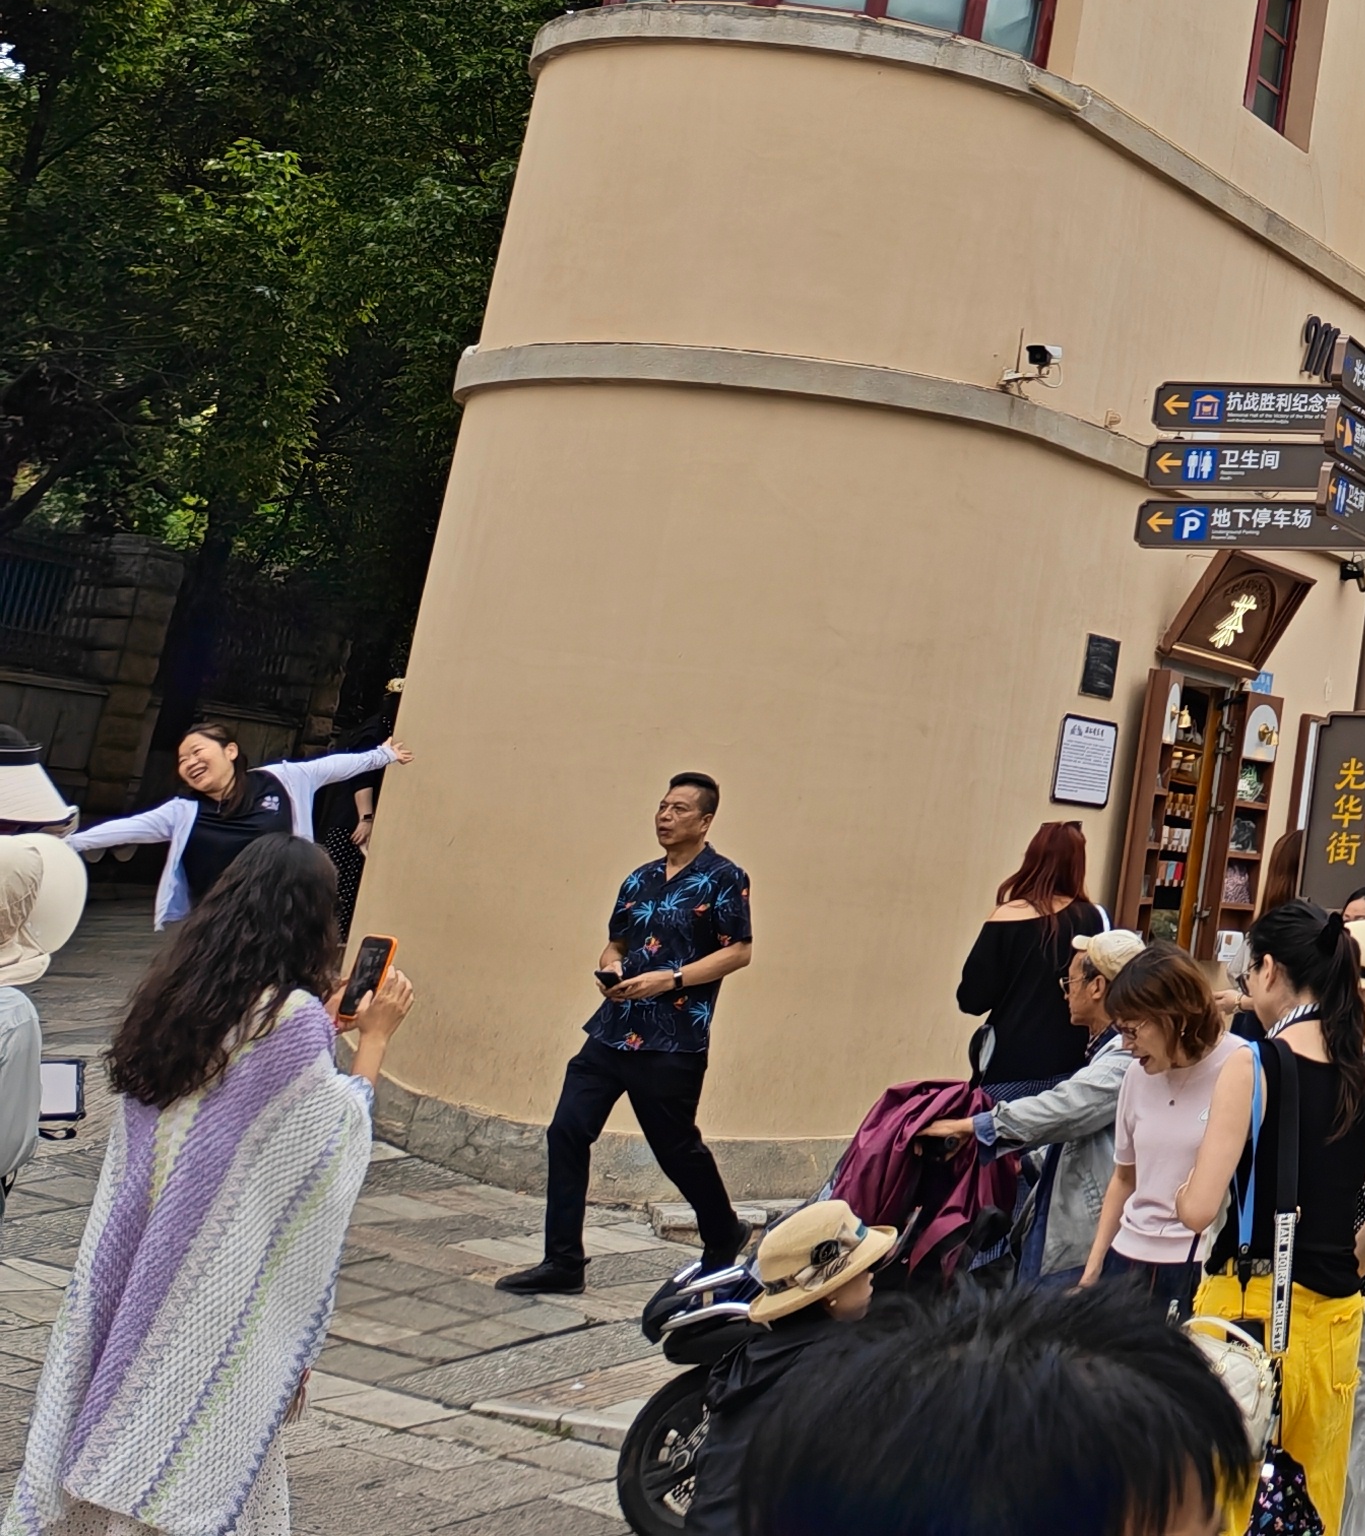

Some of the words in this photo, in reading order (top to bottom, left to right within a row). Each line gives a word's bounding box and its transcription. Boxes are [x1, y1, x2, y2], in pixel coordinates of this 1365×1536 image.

[1219, 450, 1280, 470] 卫生间
[1346, 483, 1365, 512] 卫生间
[1210, 508, 1312, 529] 地下停车场
